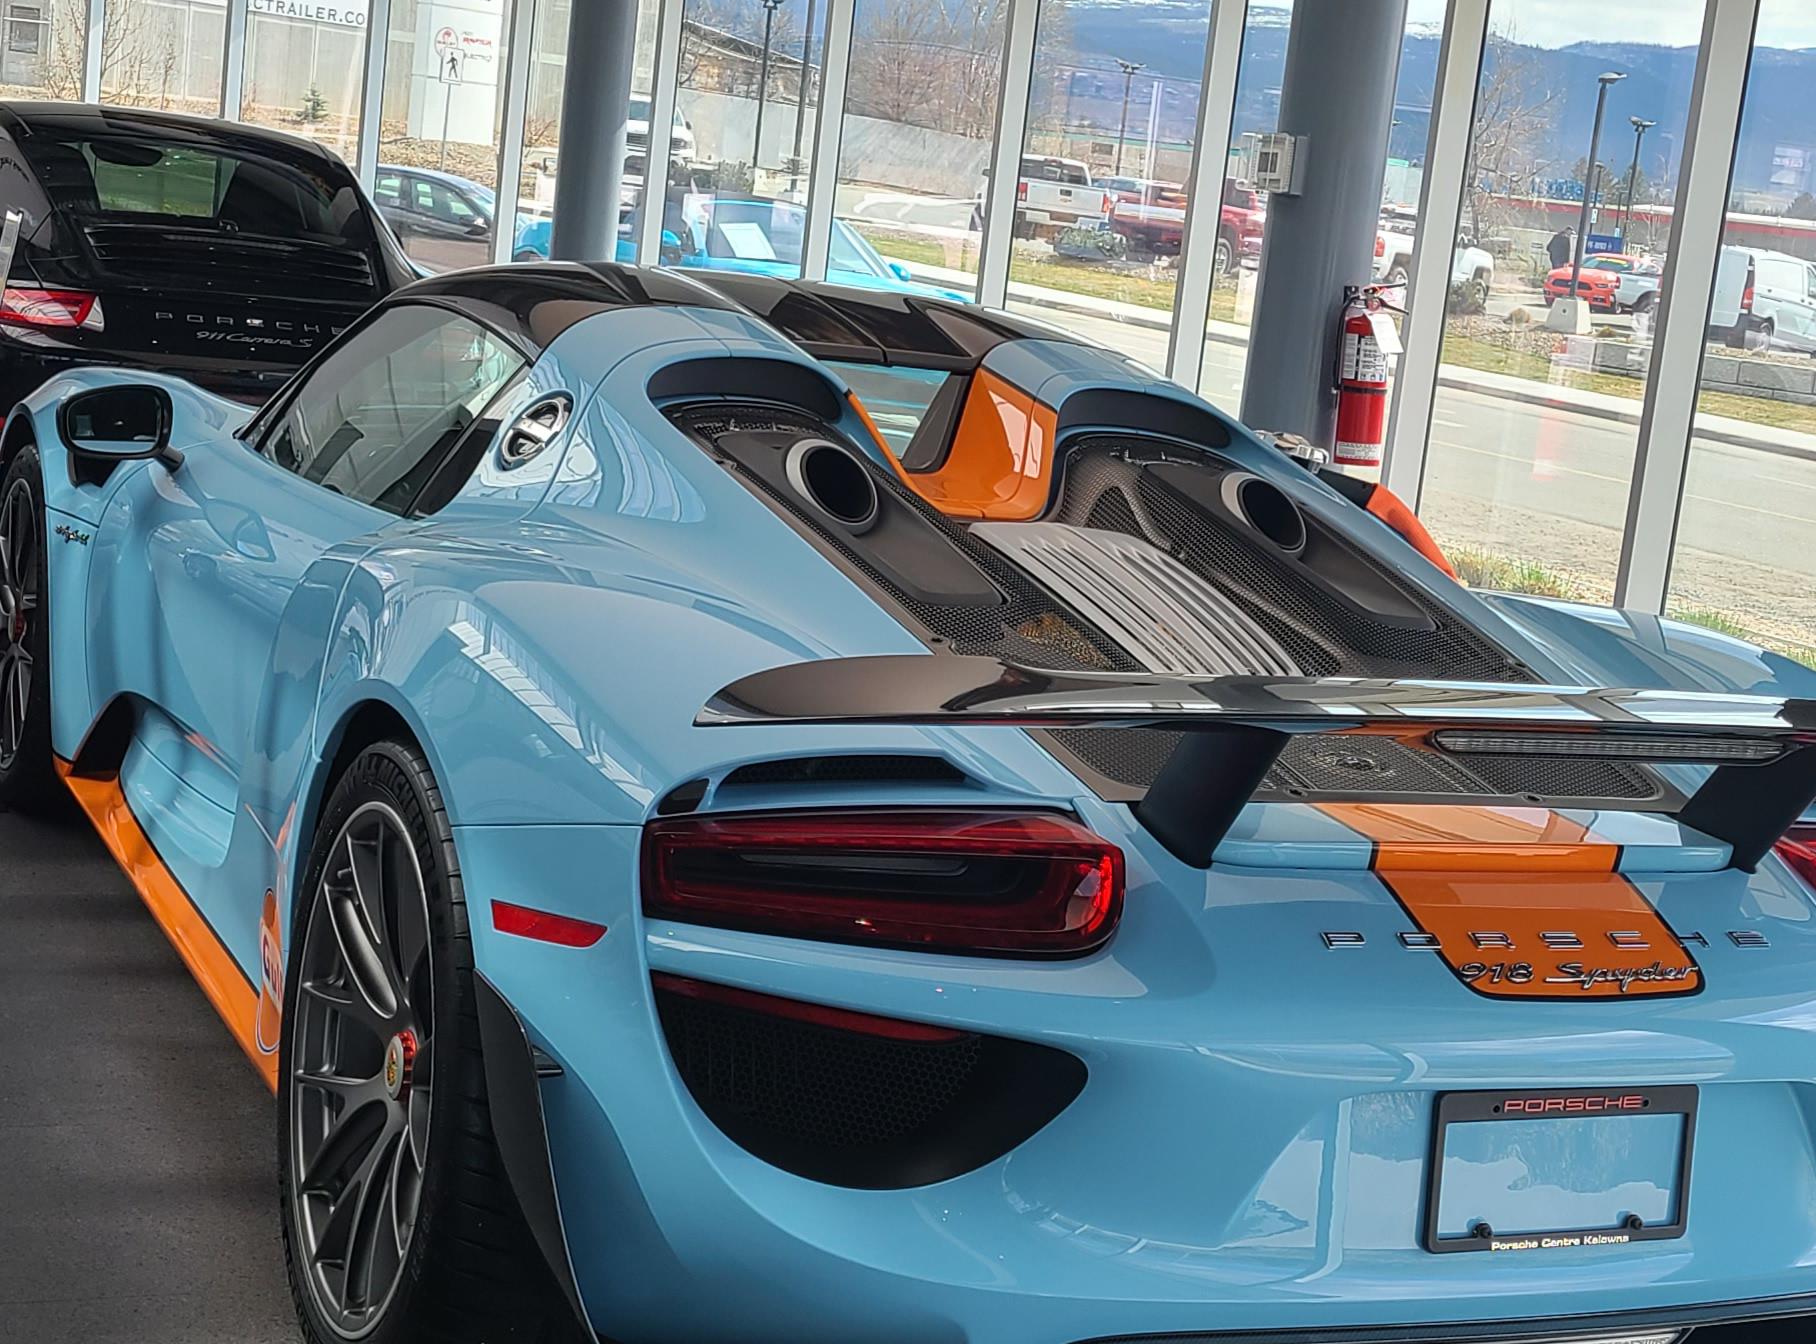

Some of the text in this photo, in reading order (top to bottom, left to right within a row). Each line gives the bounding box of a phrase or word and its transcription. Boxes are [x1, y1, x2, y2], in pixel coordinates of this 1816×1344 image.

[1320, 930, 1770, 953] PORSCHE
[1458, 960, 1699, 993] 918 Spyder
[1503, 1094, 1643, 1114] PORSCHE
[1491, 1234, 1629, 1251] Porsche Centre Kelowna
